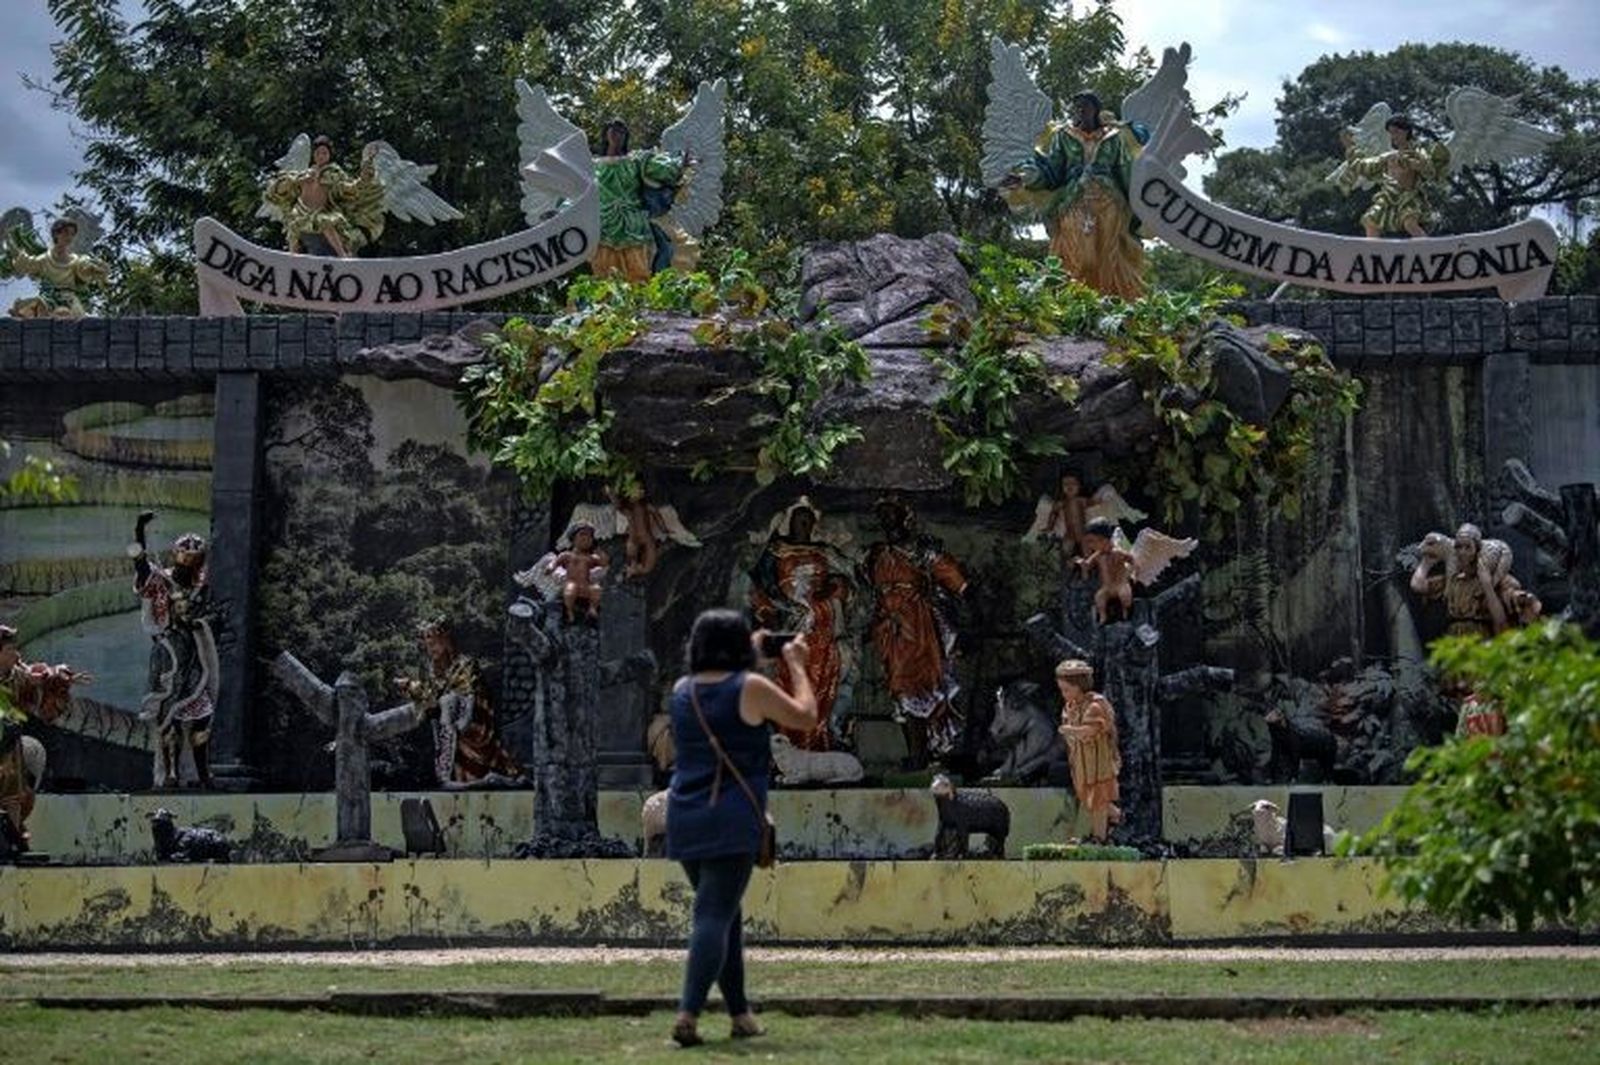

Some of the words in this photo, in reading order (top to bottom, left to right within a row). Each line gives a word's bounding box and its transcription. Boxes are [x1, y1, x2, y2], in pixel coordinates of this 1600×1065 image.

[201, 237, 278, 296] DIGA
[286, 264, 362, 303] NÃO
[375, 273, 423, 304] AO
[432, 226, 588, 299] RACISMO
[1141, 177, 1277, 272] CUIDEM
[1283, 245, 1335, 282] DA
[1347, 239, 1552, 284] AMAZÔNIA
